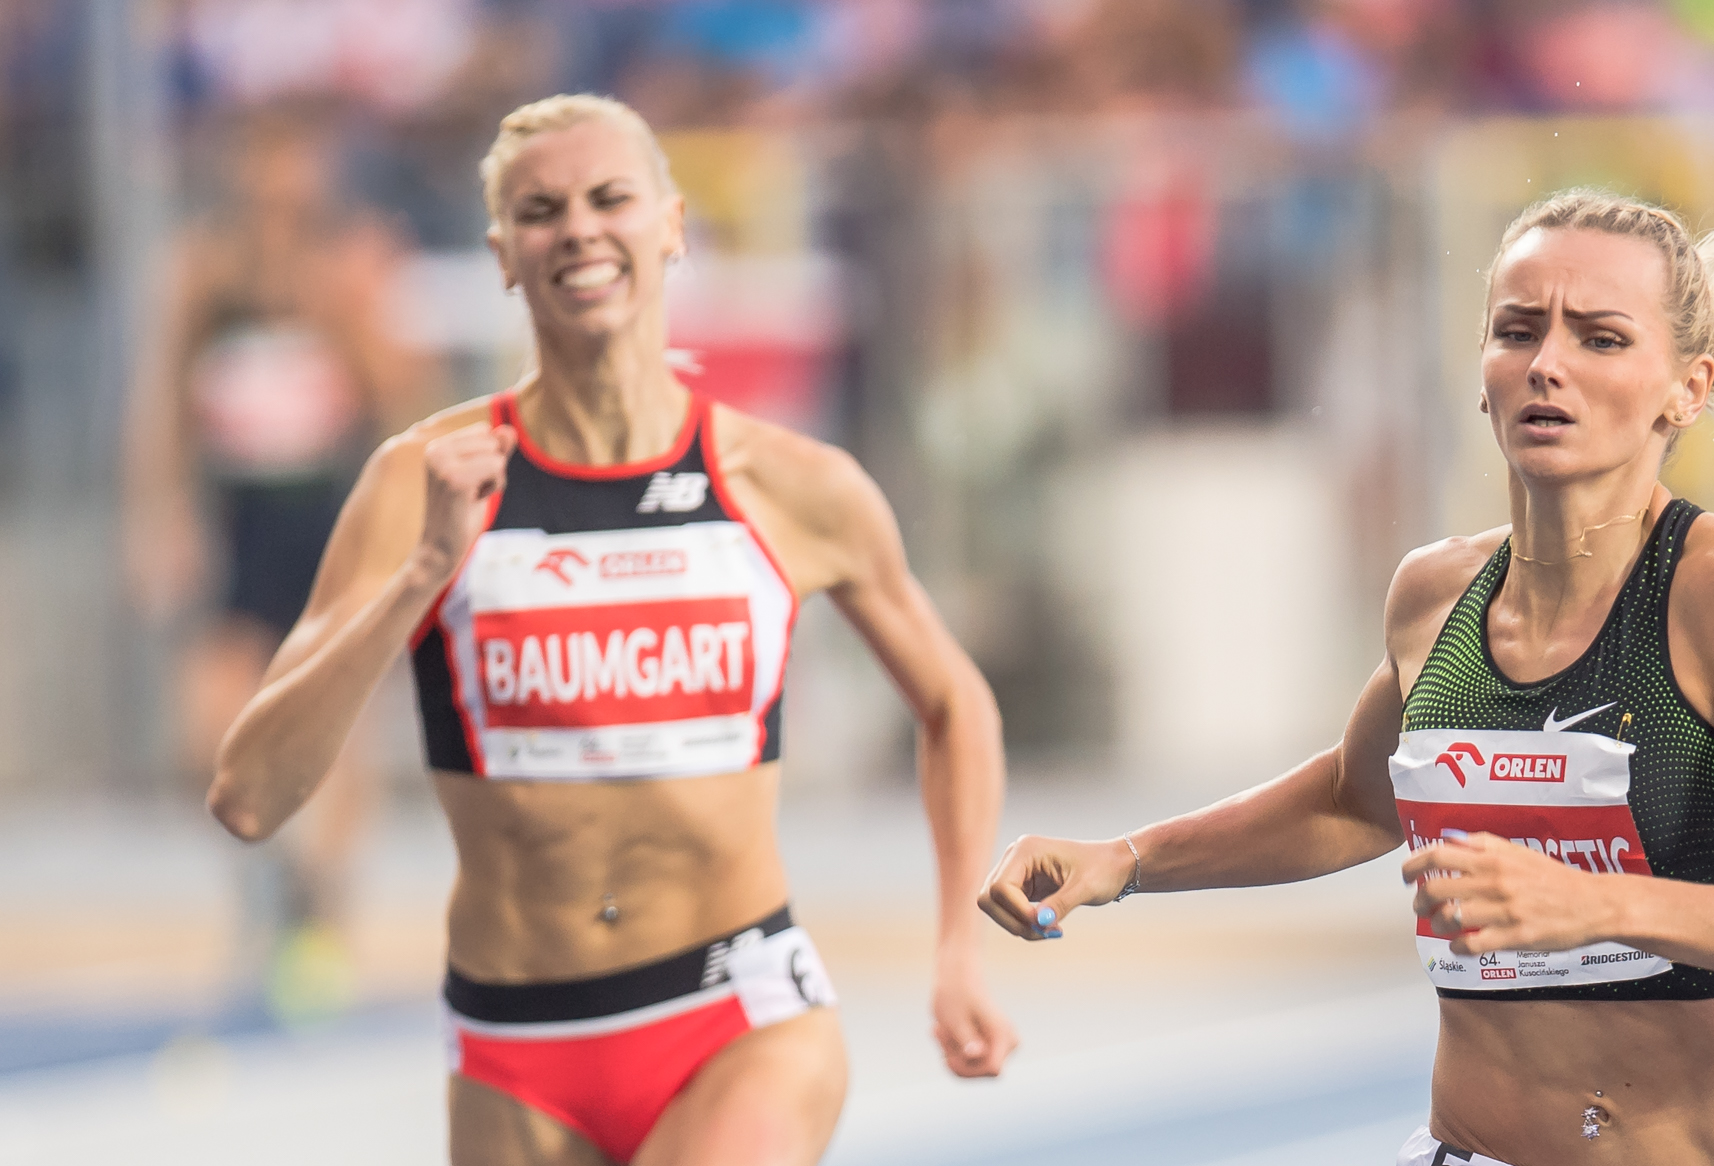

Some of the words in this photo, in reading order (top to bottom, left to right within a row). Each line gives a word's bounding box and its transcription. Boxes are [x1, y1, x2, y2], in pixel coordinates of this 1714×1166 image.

[484, 620, 749, 706] BAUMGART
[1494, 756, 1562, 780] ORLEN
[1483, 970, 1515, 979] ORLEN
